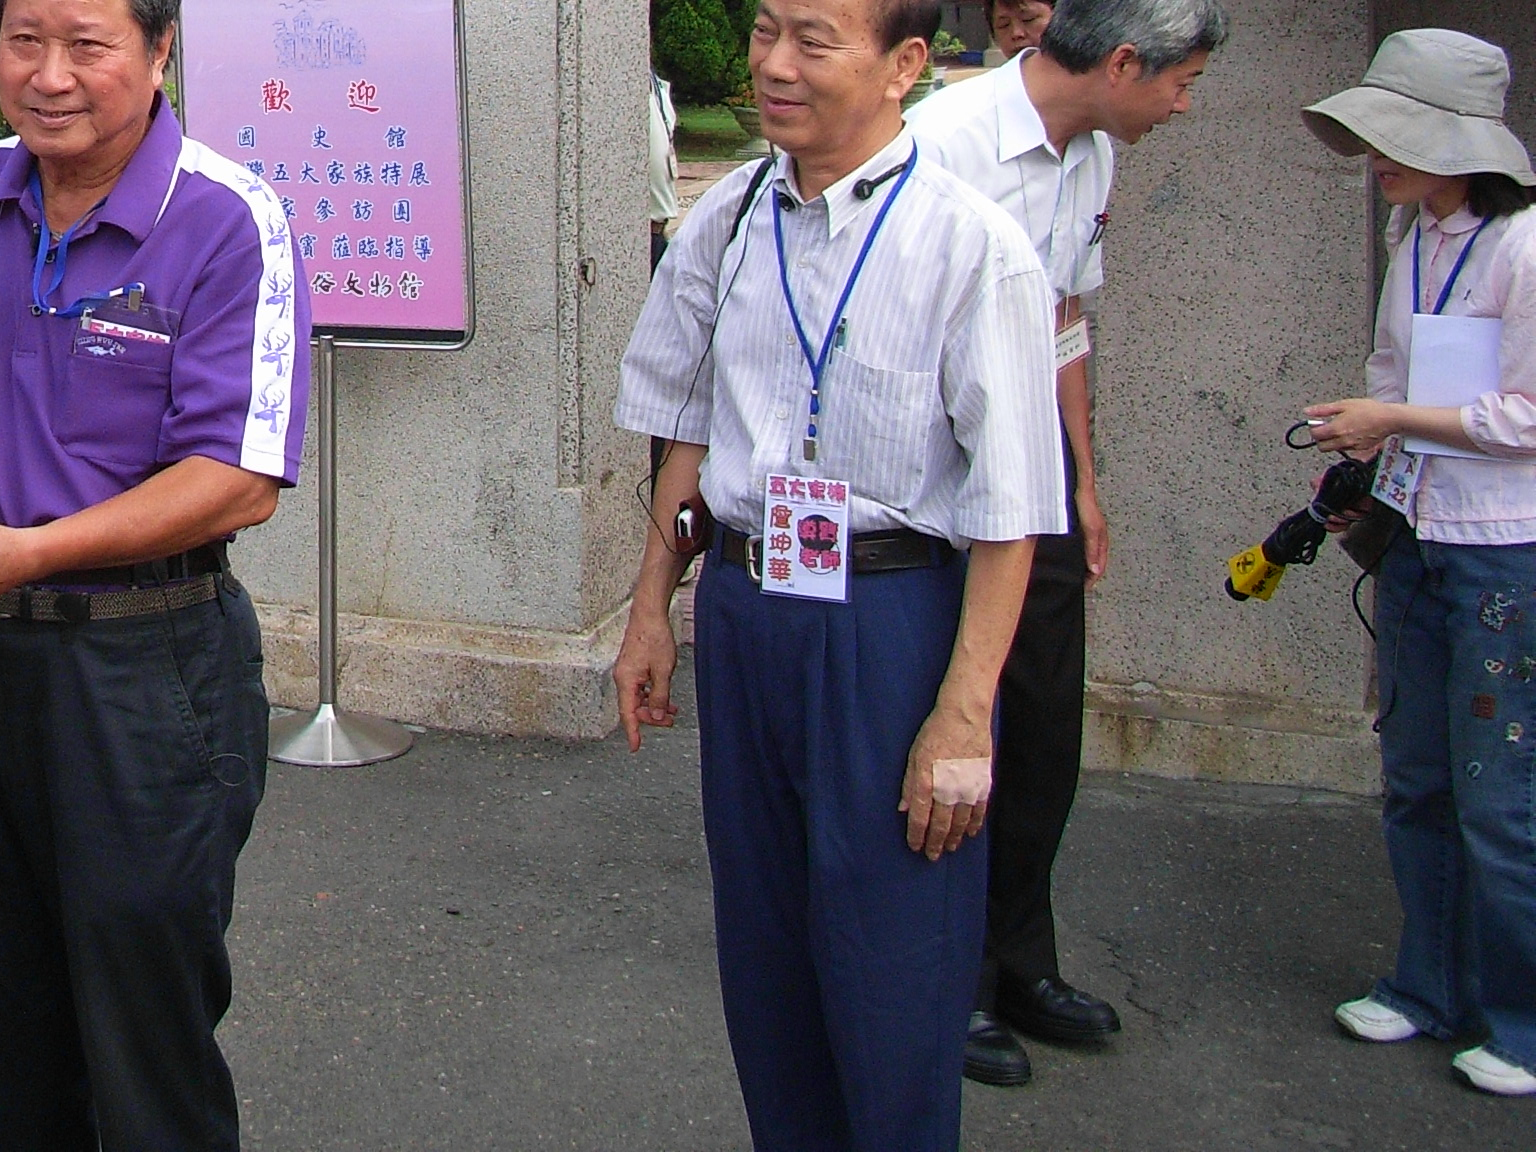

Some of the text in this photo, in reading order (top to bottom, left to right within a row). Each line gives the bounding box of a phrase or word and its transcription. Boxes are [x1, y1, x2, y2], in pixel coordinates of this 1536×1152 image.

[261, 79, 380, 114] 歡迎
[238, 126, 407, 150] 國史館
[311, 272, 424, 300] 俗文物館
